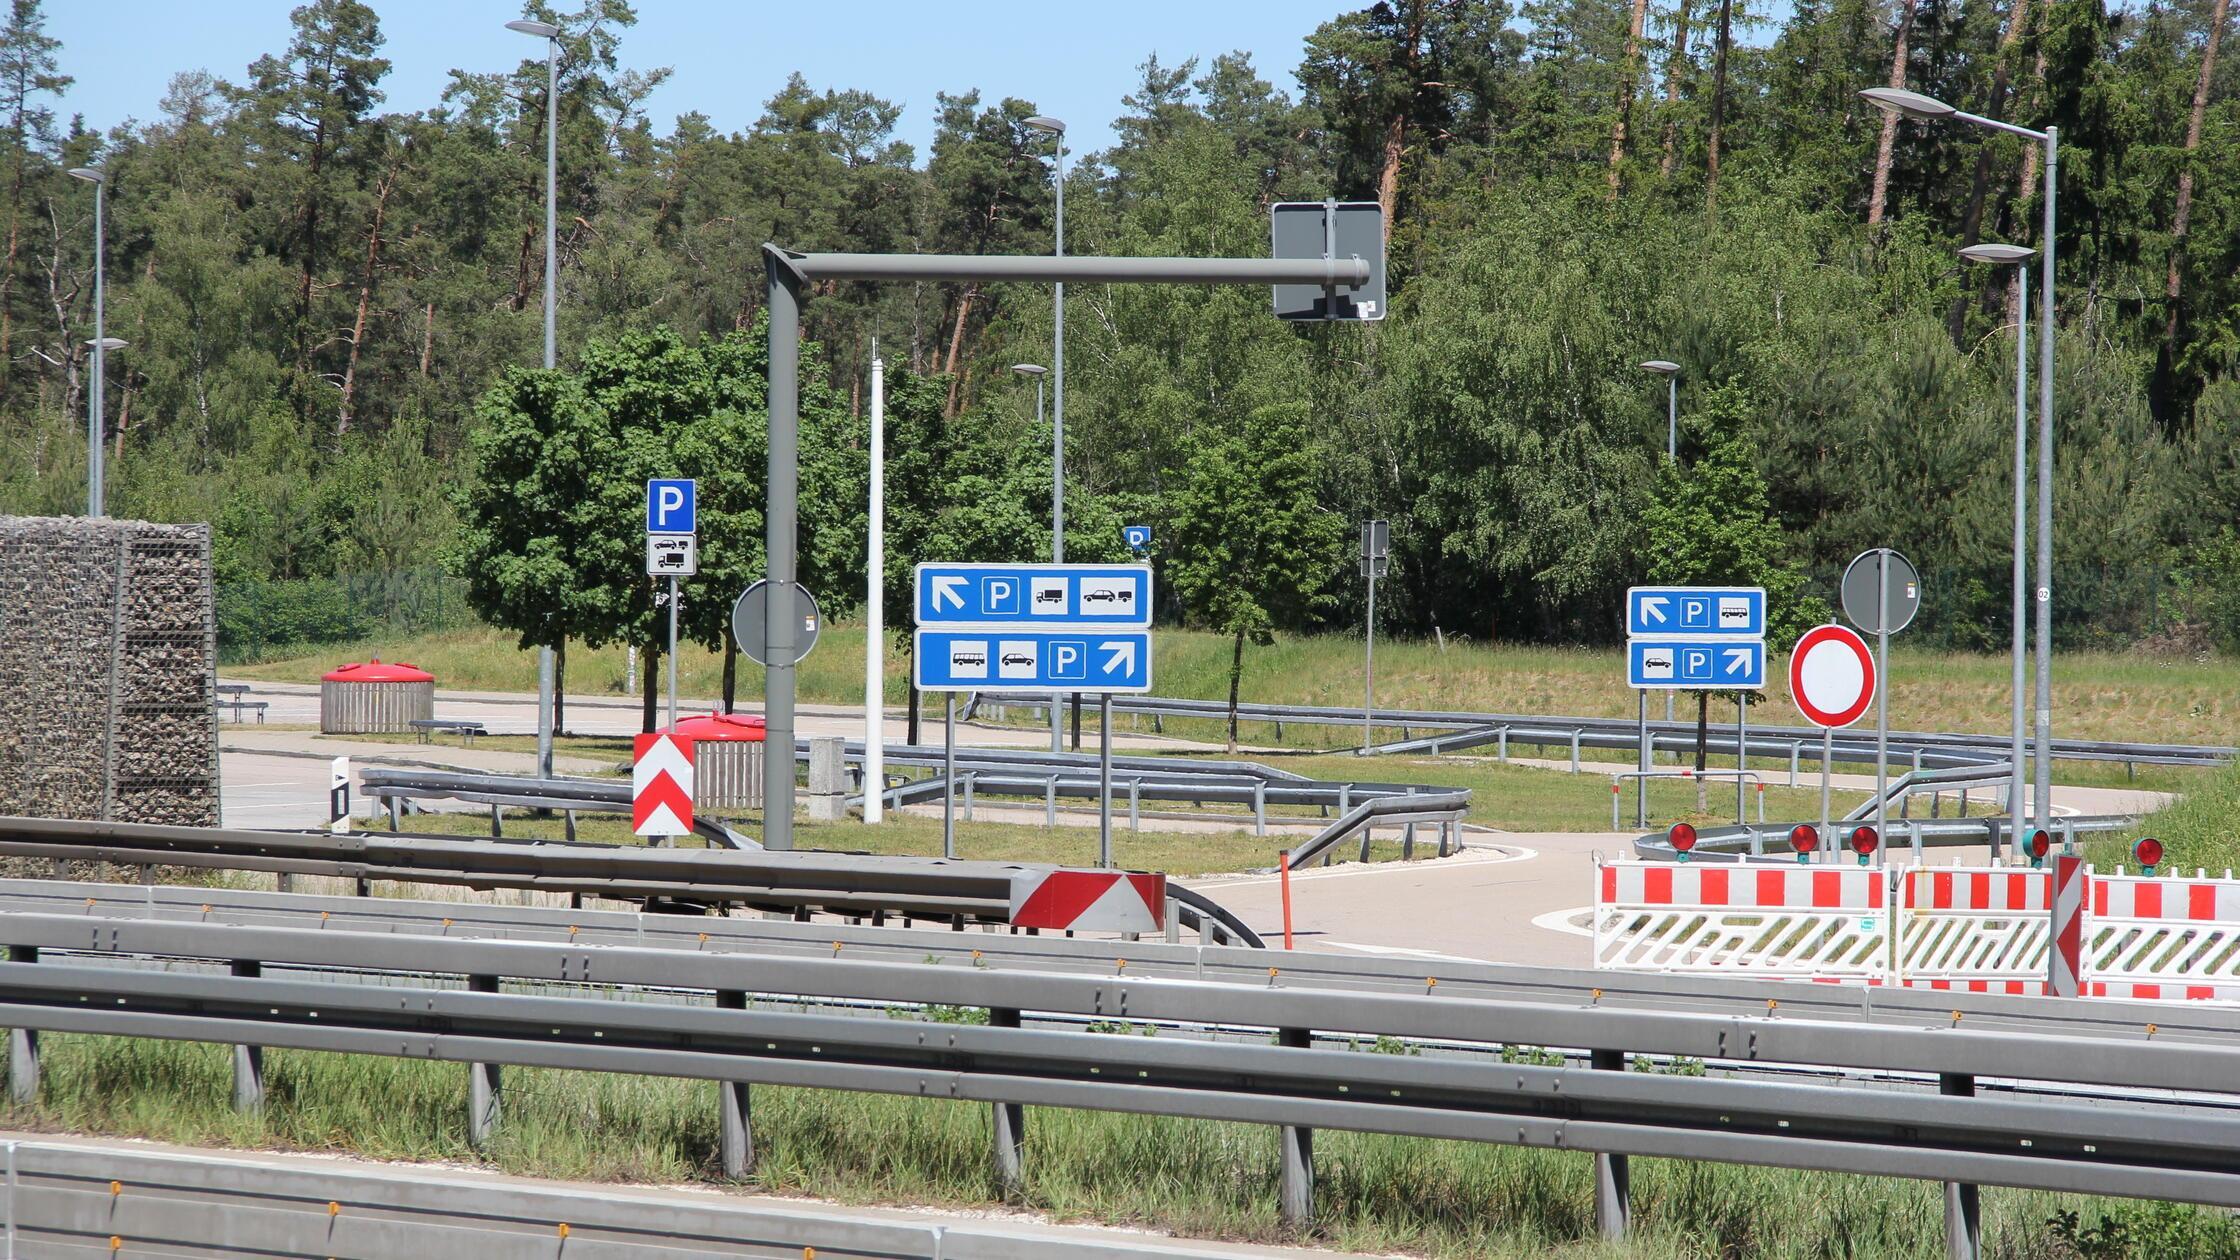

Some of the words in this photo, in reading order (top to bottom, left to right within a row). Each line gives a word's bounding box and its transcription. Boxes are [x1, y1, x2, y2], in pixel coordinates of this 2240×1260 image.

[659, 486, 683, 526] P
[990, 582, 1011, 609] P
[2038, 590, 2049, 599] 02
[1687, 601, 1703, 623] P
[1057, 646, 1077, 674] P
[1689, 652, 1706, 675] P
